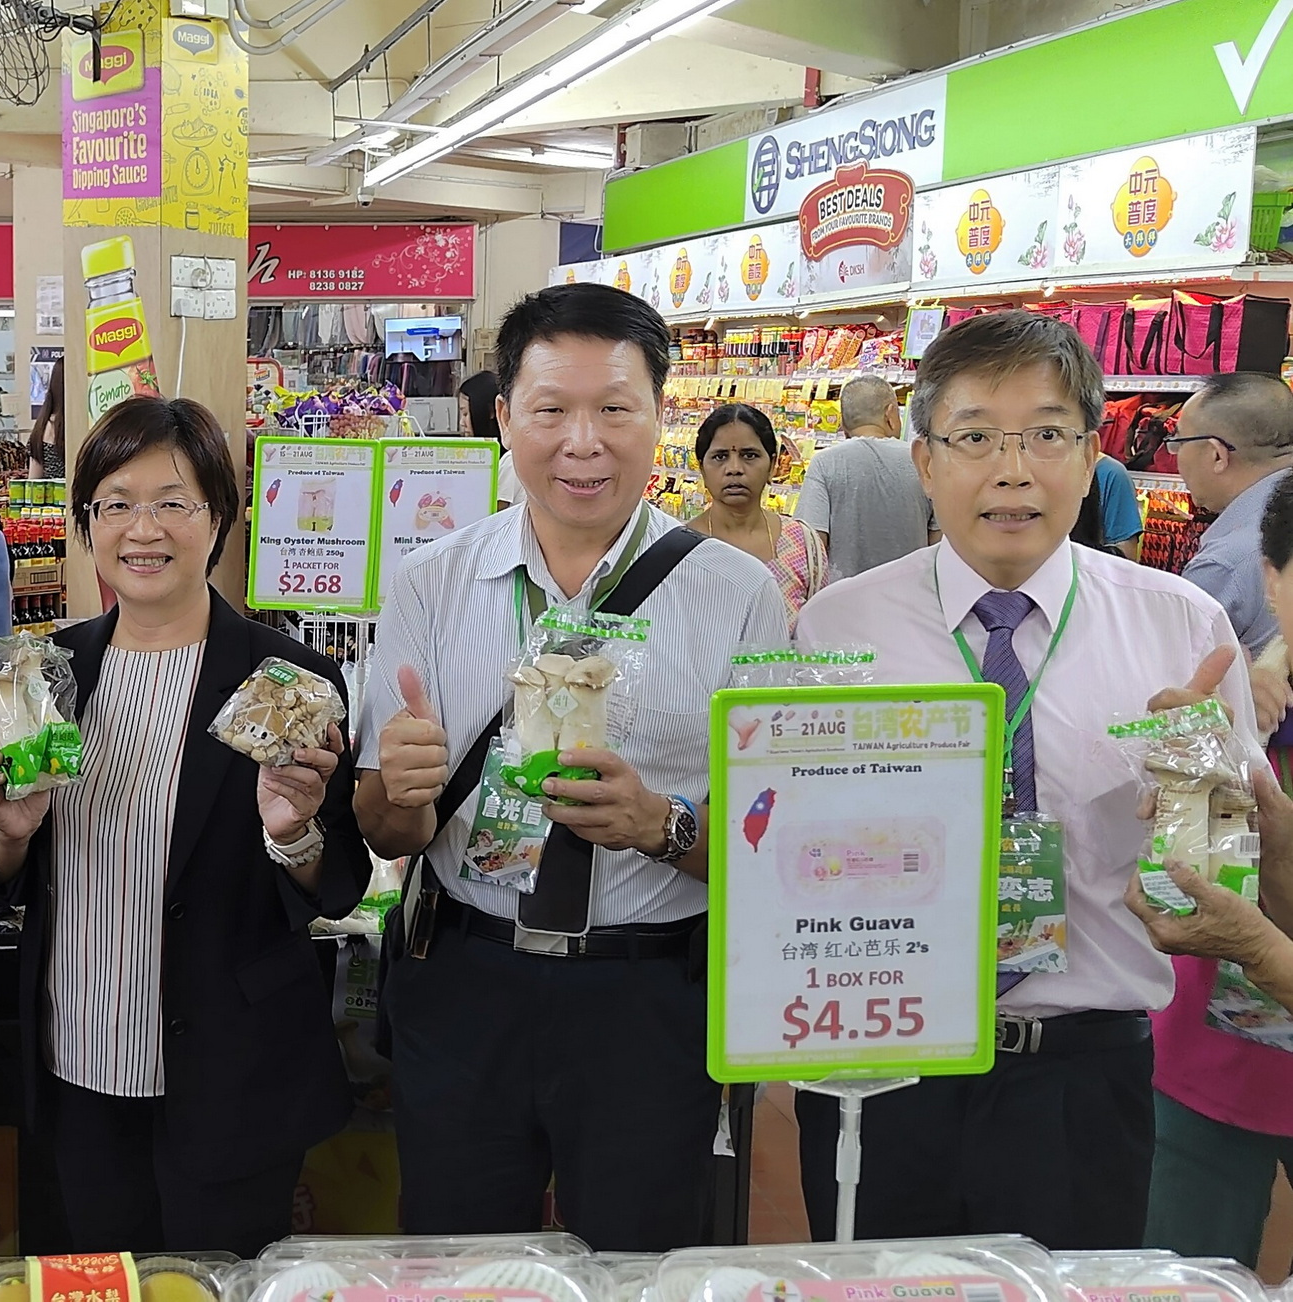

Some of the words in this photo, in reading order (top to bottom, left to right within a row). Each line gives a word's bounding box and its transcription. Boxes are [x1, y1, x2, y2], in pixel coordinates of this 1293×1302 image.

[177, 29, 210, 46] Maggi
[84, 52, 127, 73] Mggi
[72, 103, 147, 134] Singapore's
[72, 131, 147, 165] Favourite
[72, 166, 110, 191] Dipping
[112, 164, 148, 184] Sauce
[1129, 168, 1157, 195] 中元
[819, 190, 845, 221] BEST
[846, 186, 885, 210] DEALS
[1127, 198, 1158, 226] 普度
[811, 226, 825, 241] FROM
[824, 219, 839, 236] YOUR
[838, 213, 869, 229] FAVOURITE
[868, 213, 893, 228] BRANDS
[288, 270, 307, 279] HP:
[309, 269, 336, 279] 8136
[338, 269, 365, 279] 9182
[849, 263, 865, 276] DKSH
[309, 281, 336, 291] 8238
[338, 281, 365, 291] 0827
[95, 323, 138, 346] Maggi
[93, 381, 131, 402] Tomato
[421, 450, 434, 458] AUG
[260, 536, 282, 547] King
[283, 536, 315, 547] Oyster
[317, 537, 366, 546] Mushroom
[394, 536, 413, 544] Mini
[325, 549, 345, 558] 250g
[283, 559, 290, 569] 1
[292, 562, 322, 570] PACKET
[323, 562, 339, 570] FOR
[278, 571, 342, 596] $2.68
[817, 721, 846, 736] AUG
[852, 704, 973, 740] 台湾农产节
[853, 742, 885, 751] TAIWAN
[886, 741, 929, 751] Agriculture
[930, 740, 957, 749] Produce
[958, 740, 971, 748] Fair
[791, 765, 849, 777] Produce
[852, 764, 867, 775] of
[869, 763, 923, 774] Taiwan
[795, 917, 842, 933] Pink
[849, 916, 915, 932] Guava
[782, 942, 818, 960] 台湾
[825, 938, 900, 959] 红心芭乐
[905, 942, 929, 954] 2's
[806, 967, 820, 989] 1
[826, 971, 863, 987] BOX
[869, 970, 904, 985] FOR
[782, 995, 925, 1049] $4.55
[845, 1286, 886, 1300] Pink
[891, 1284, 956, 1298] Guava
